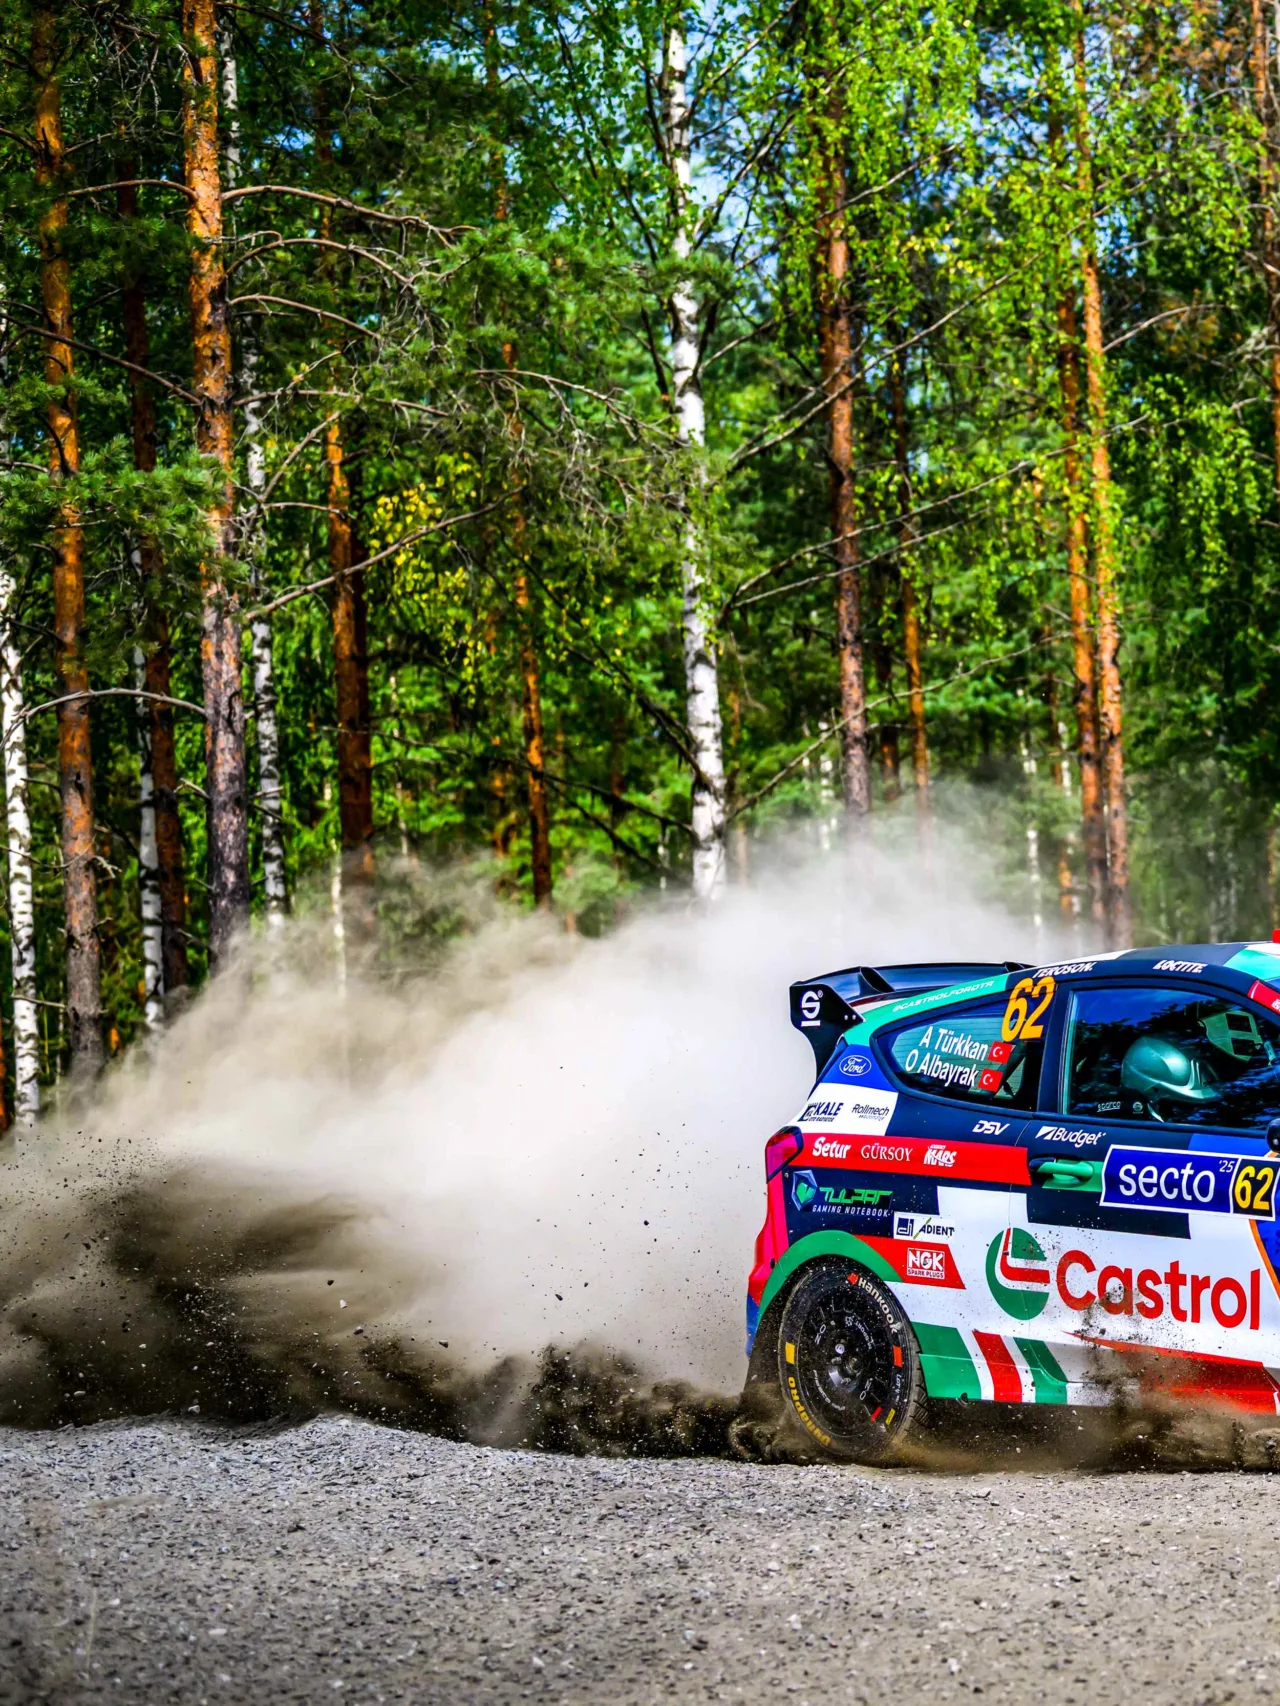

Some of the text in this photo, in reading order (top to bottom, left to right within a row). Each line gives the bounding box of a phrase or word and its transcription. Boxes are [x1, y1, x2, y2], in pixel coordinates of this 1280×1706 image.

[1153, 960, 1208, 973] LOCTITE
[1001, 976, 1057, 1042] 62
[919, 1026, 988, 1061] A Türkkan
[841, 1055, 869, 1075] Ford
[905, 1049, 979, 1087] O Albayrak
[812, 1101, 844, 1116] KALE
[851, 1103, 890, 1116] Rollmech
[972, 1120, 1010, 1135] DSV
[1052, 1127, 1102, 1148] Budget
[812, 1136, 851, 1159] Setur
[860, 1143, 914, 1162] GÜRSOY
[1119, 1161, 1216, 1203] secto
[1234, 1165, 1274, 1211] 62
[812, 1204, 889, 1217] GAMING NOTEBOOK
[919, 1224, 954, 1236] ADIENT
[908, 1250, 945, 1271] NGK
[1055, 1249, 1261, 1330] Castrol
